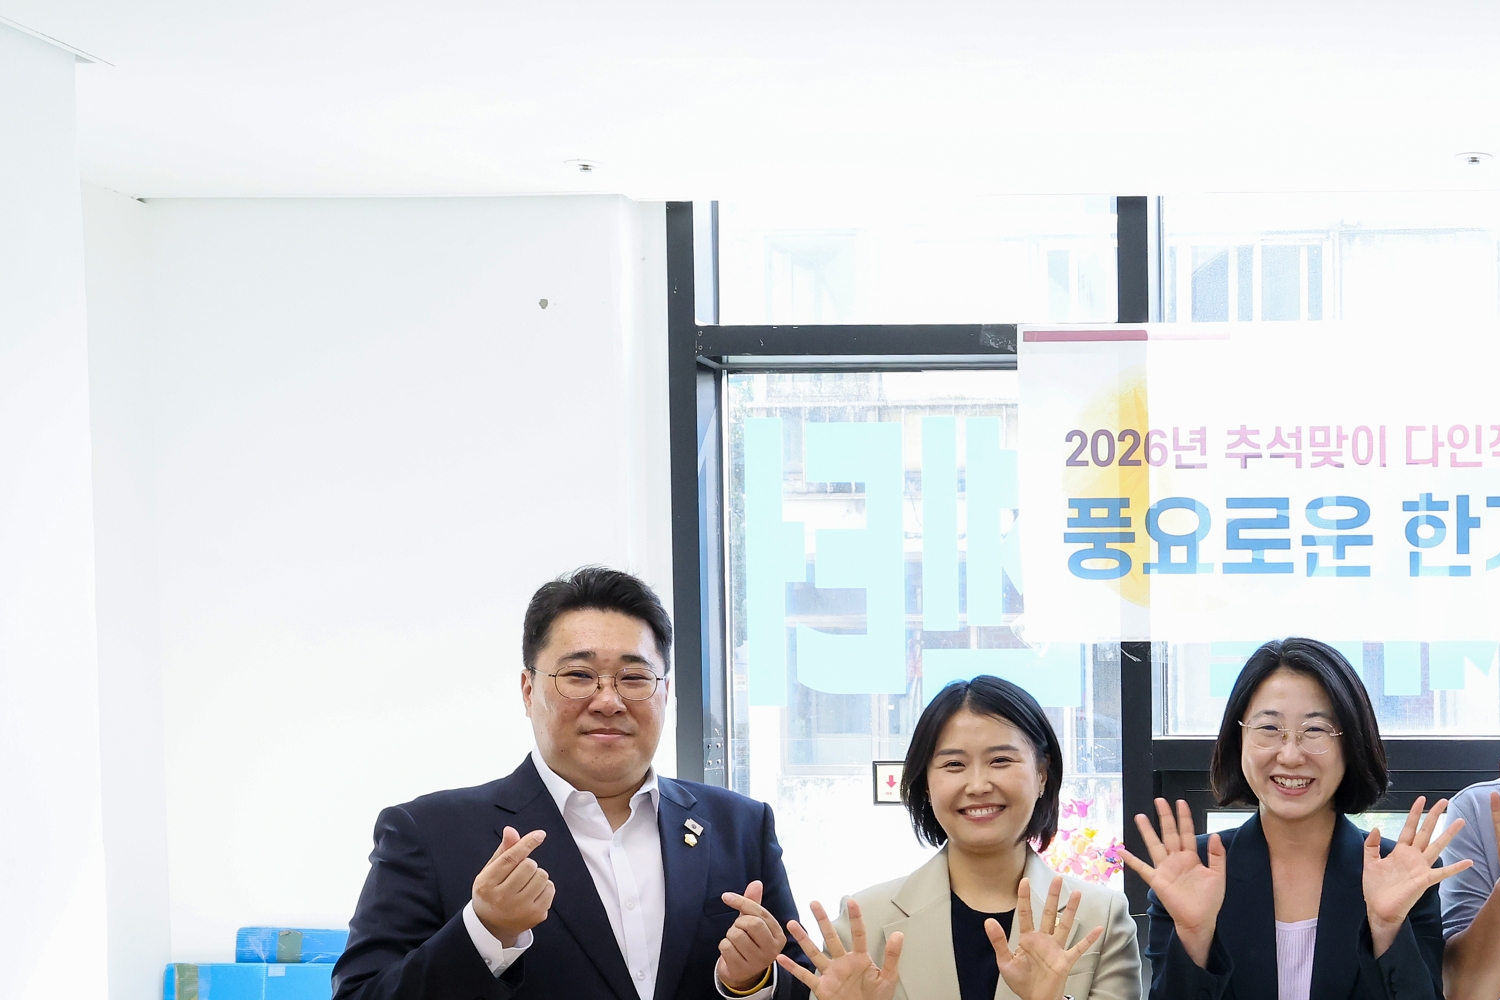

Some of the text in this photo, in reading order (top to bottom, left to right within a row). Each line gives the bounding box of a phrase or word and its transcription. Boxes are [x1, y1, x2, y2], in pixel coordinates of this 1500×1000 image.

[1065, 426, 1208, 469] 2026년
[1225, 424, 1387, 469] 추석맞이
[1063, 495, 1374, 580] 풍요로운
